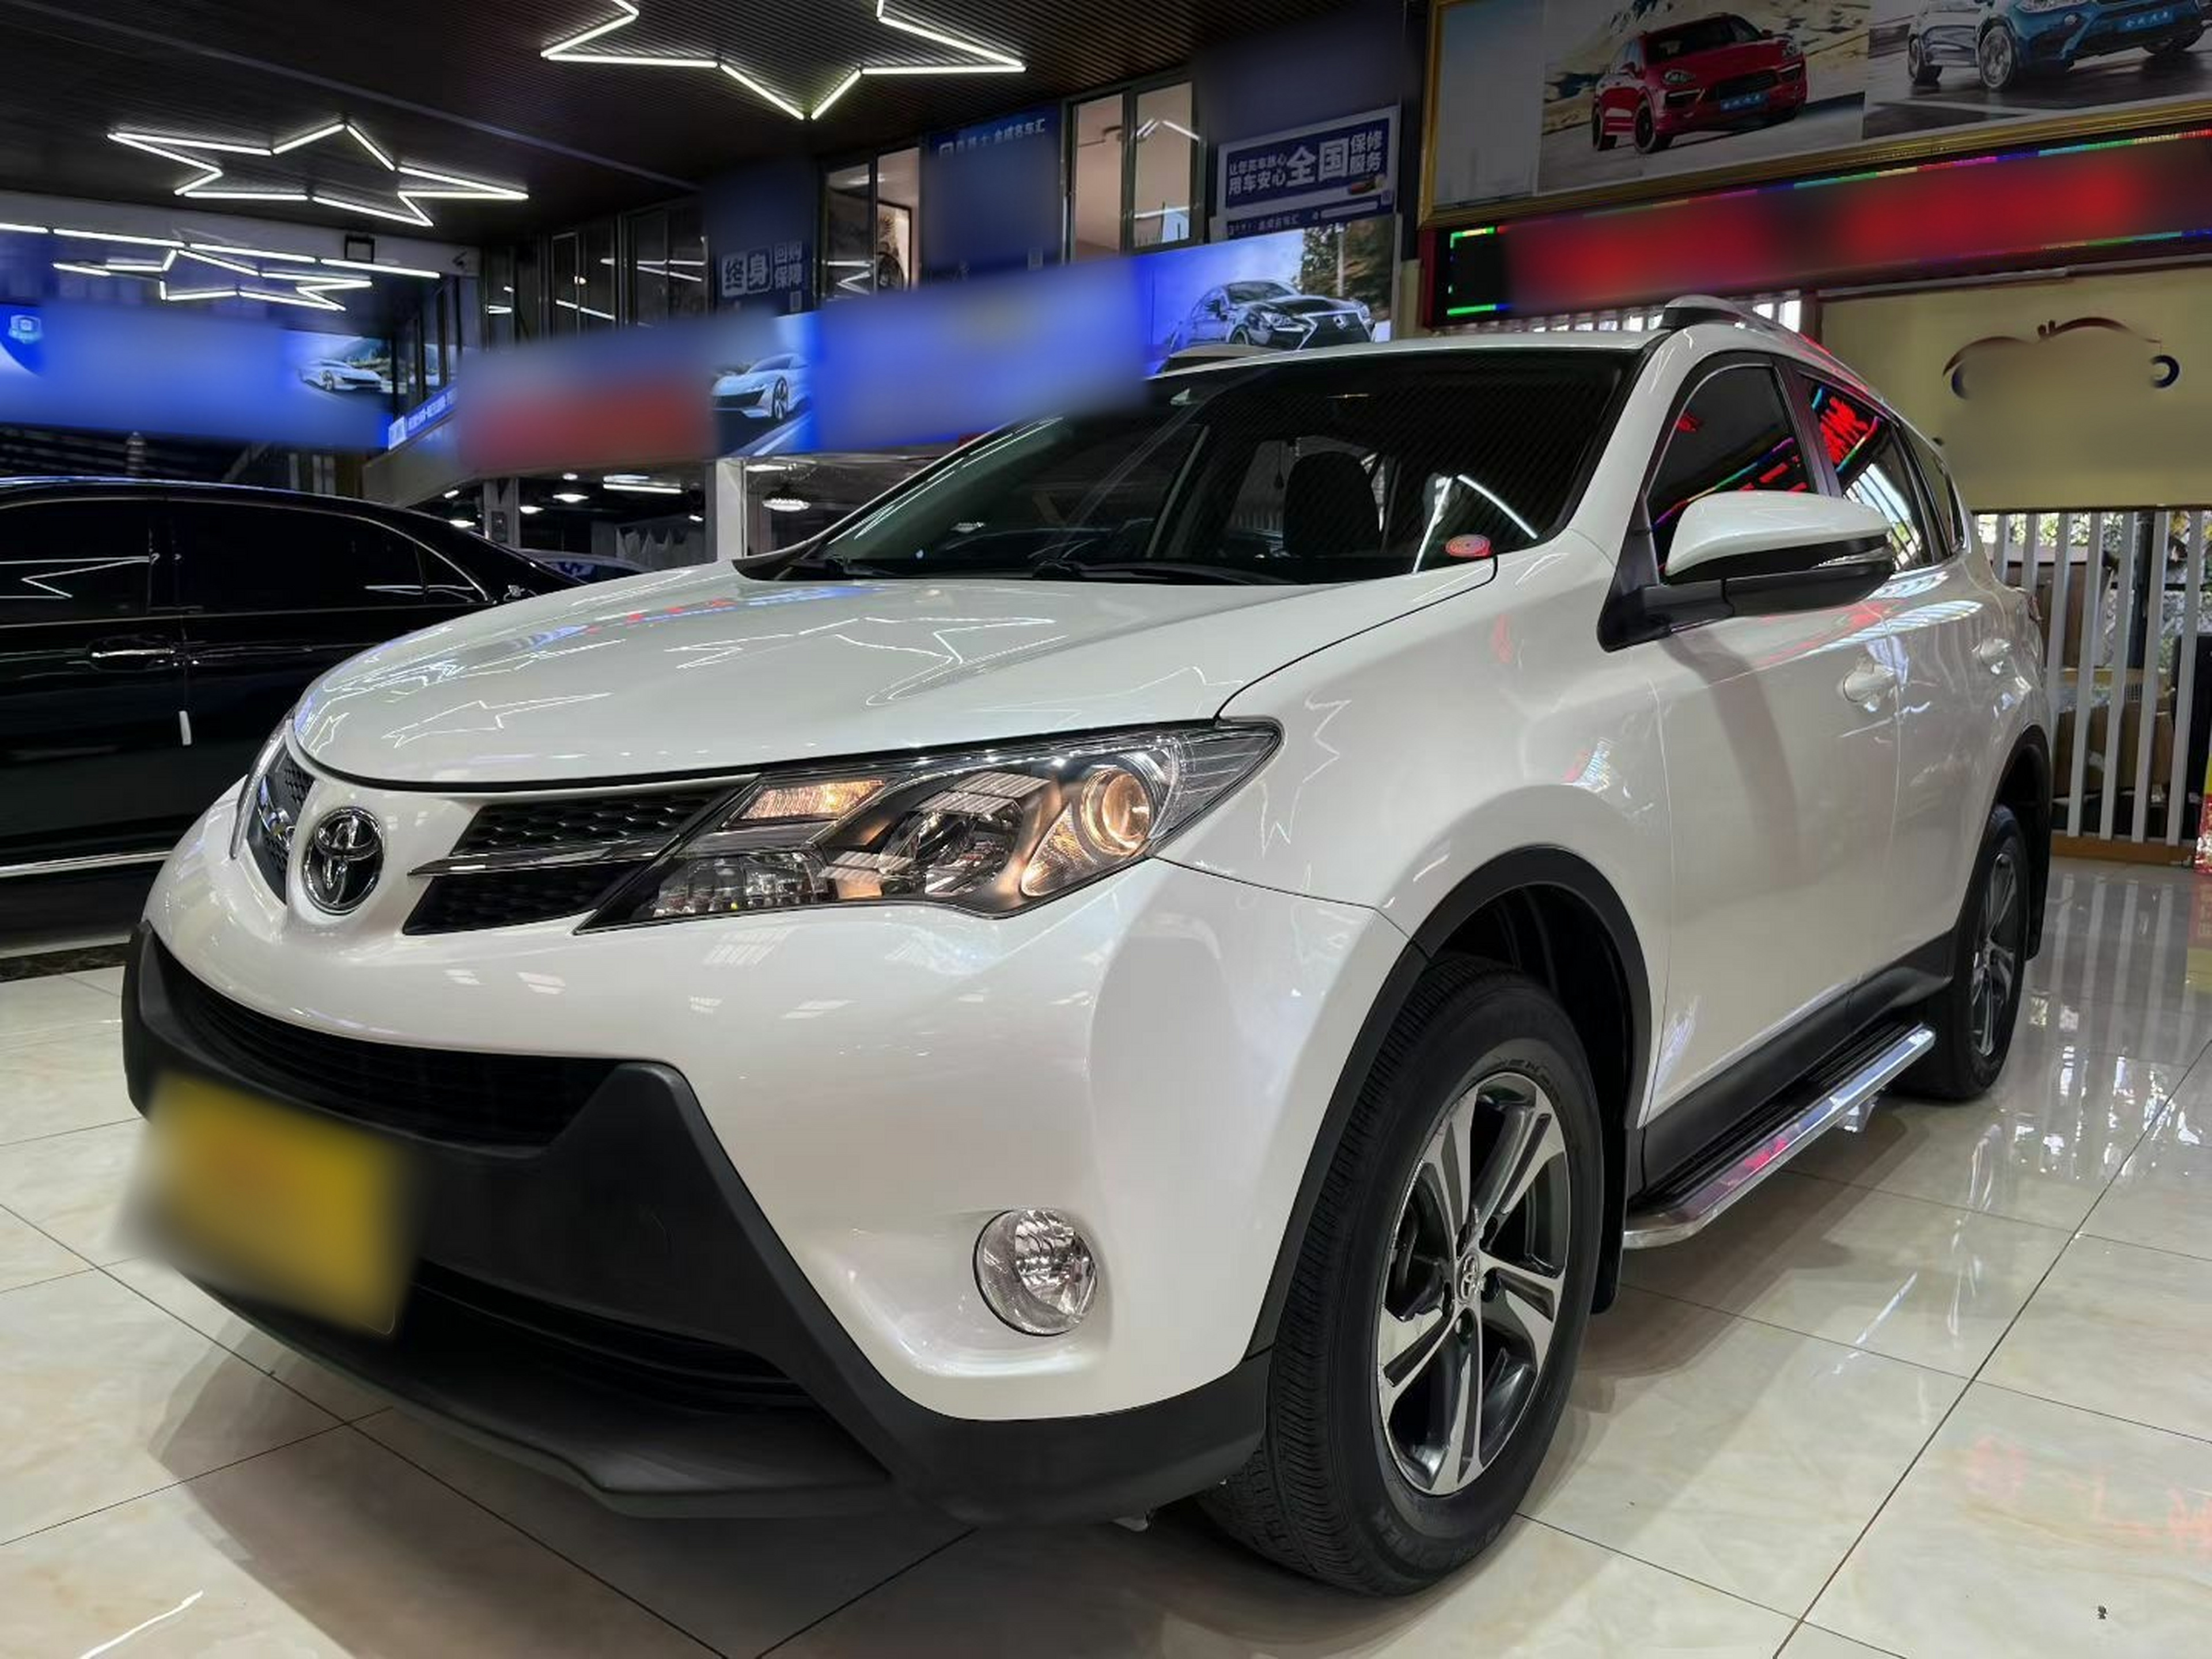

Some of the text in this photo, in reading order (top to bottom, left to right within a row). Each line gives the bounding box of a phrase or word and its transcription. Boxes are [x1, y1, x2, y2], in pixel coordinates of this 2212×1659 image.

[1350, 131, 1382, 153] 保修
[1286, 138, 1349, 187] 全国
[1350, 152, 1381, 173] 服务
[1228, 172, 1286, 195] 用车安心
[724, 253, 768, 290] 终身
